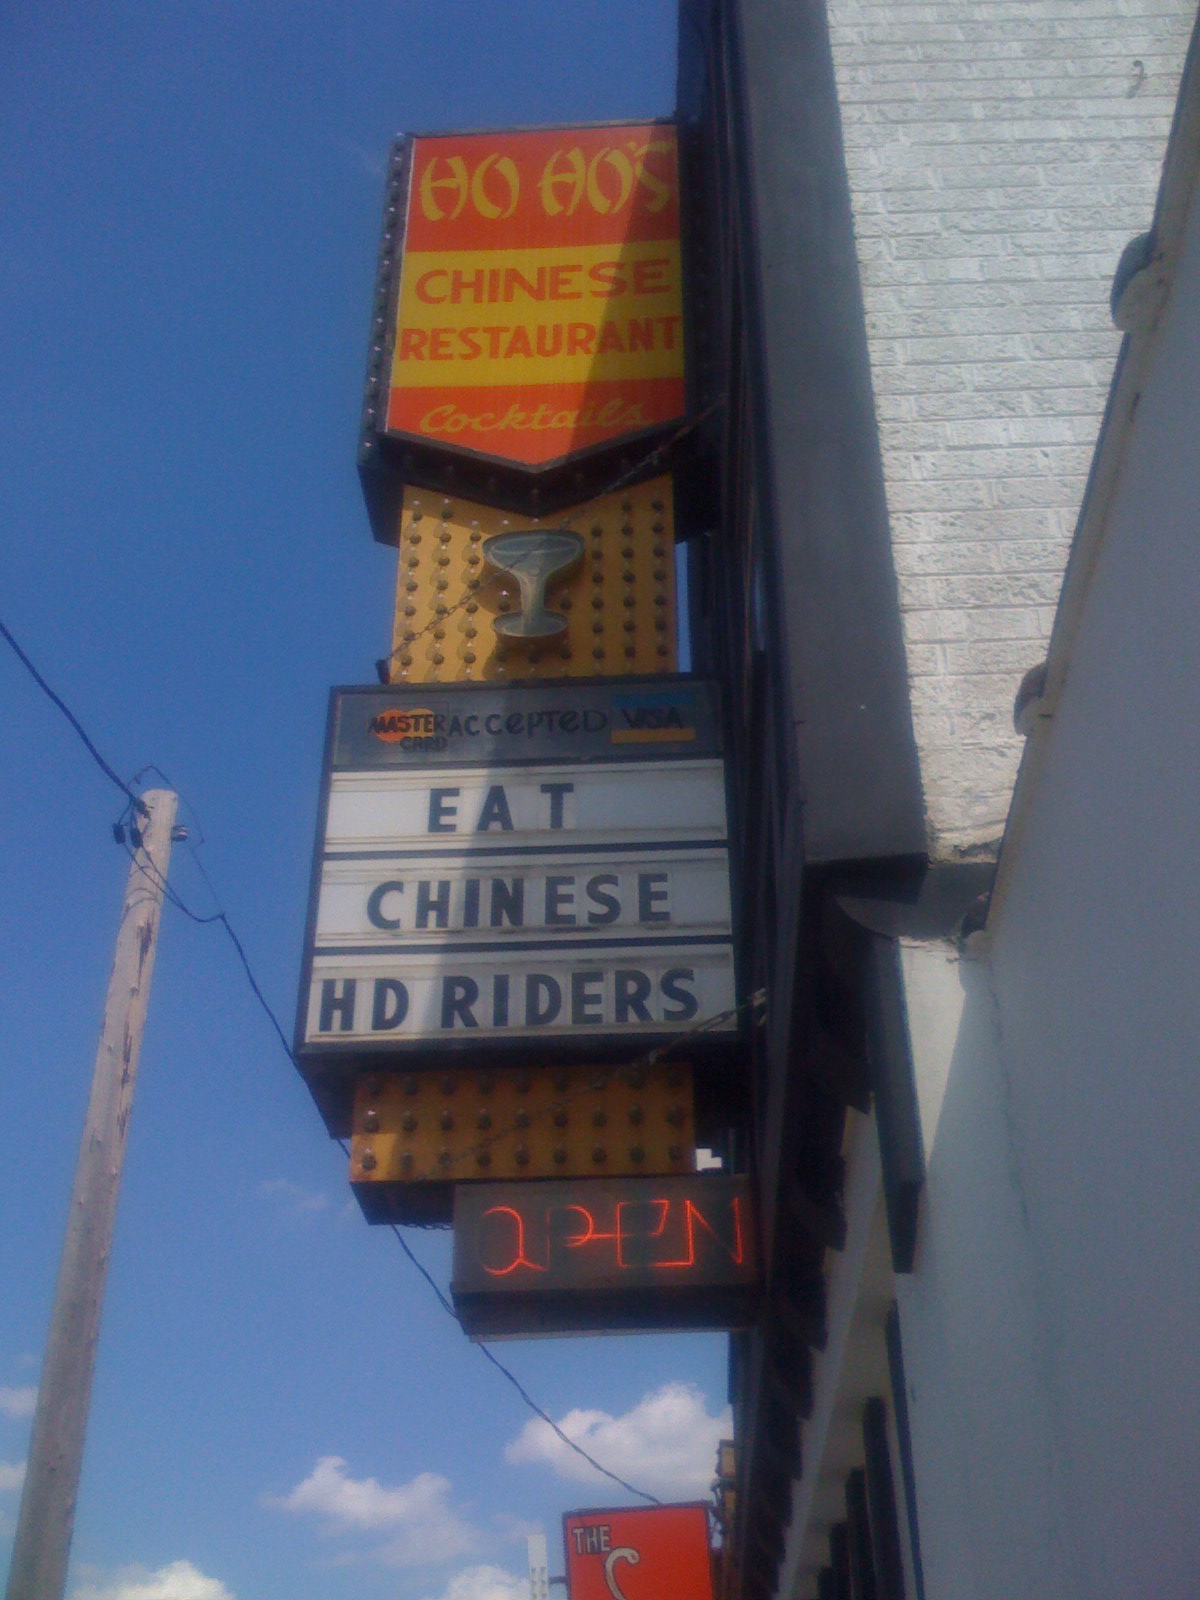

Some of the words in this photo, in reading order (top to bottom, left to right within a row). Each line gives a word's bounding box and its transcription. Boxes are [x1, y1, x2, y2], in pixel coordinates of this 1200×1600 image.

[418, 153, 520, 222] HO
[415, 258, 671, 304] CHINESE
[399, 316, 682, 361] RESTAURANT
[420, 399, 646, 433] Cocktails
[368, 713, 446, 734] MASTER
[621, 707, 684, 729] VISA
[428, 783, 574, 833] EAT
[367, 873, 671, 930] CHINESE
[318, 978, 409, 1032] HD
[441, 968, 699, 1029] RIDERS
[572, 1526, 611, 1554] THE
